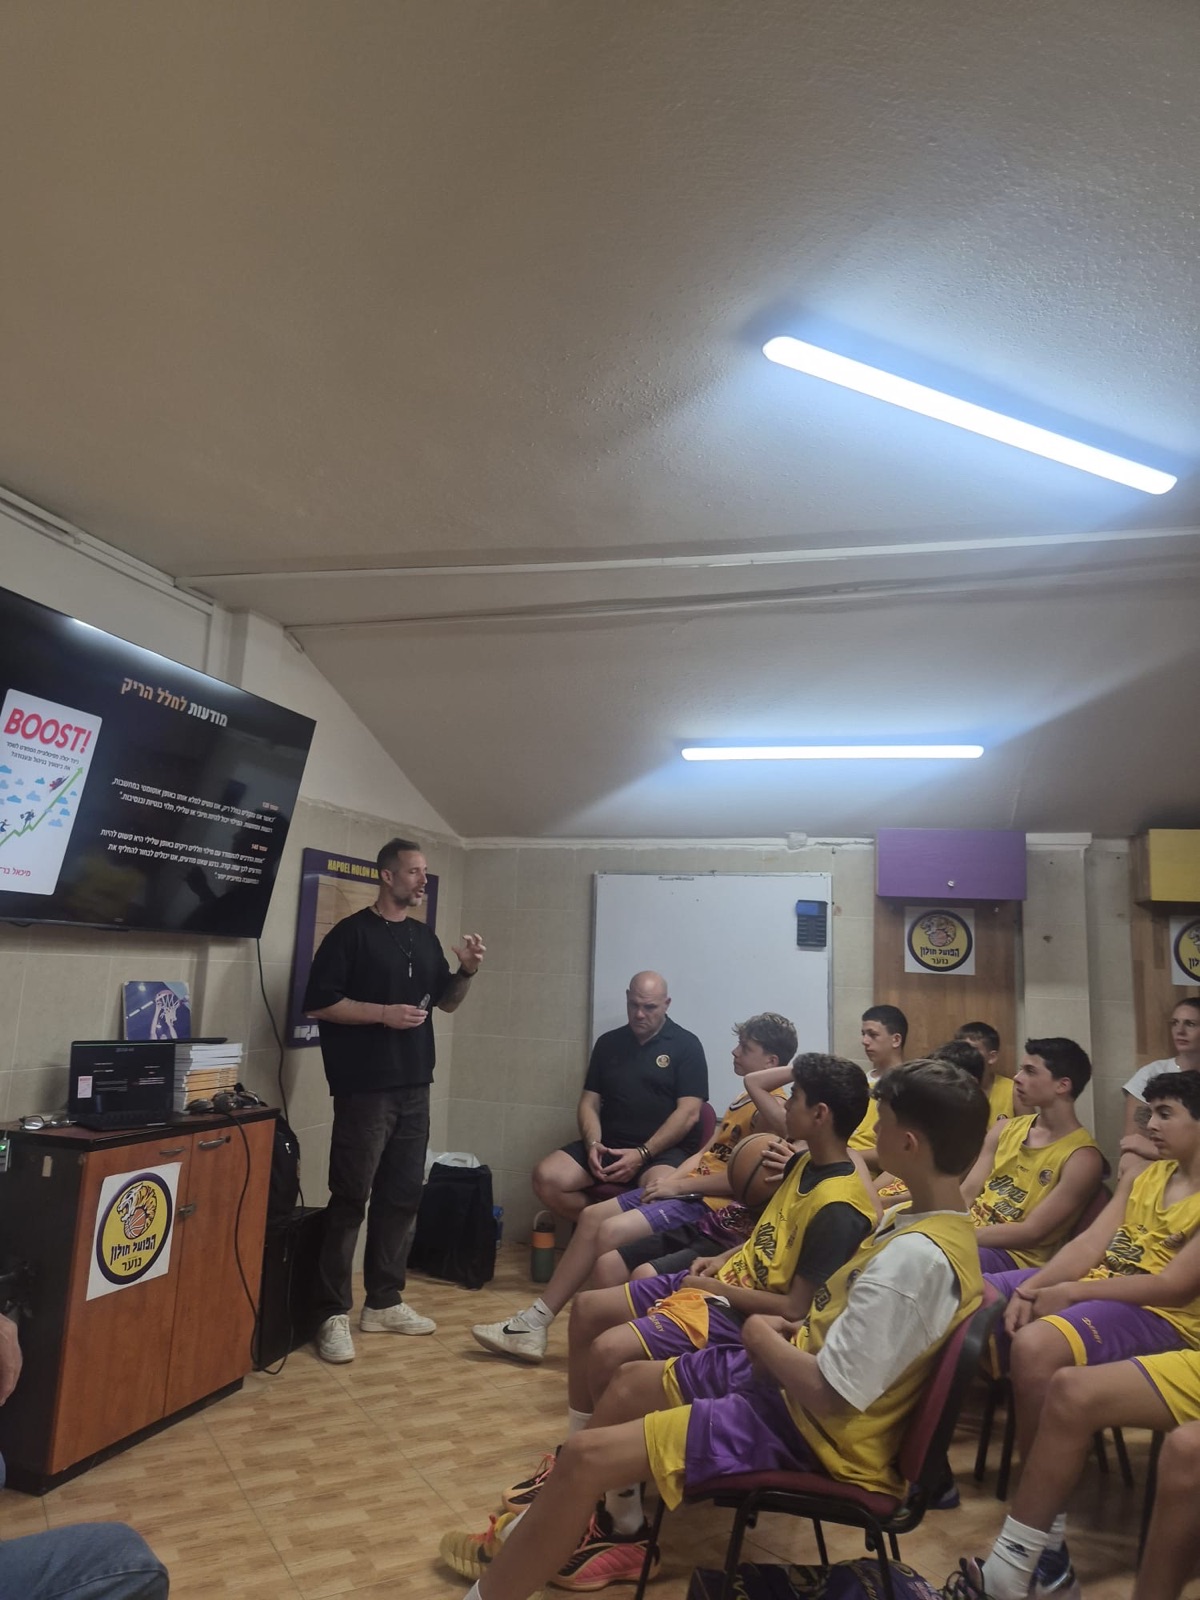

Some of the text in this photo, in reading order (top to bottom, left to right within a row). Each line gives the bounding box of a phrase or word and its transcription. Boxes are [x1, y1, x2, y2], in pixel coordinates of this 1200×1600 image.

[121, 678, 228, 727] מודעות לחלל הריק
[4, 708, 92, 754] BOOST!
[12, 867, 31, 876] מיכאל
[328, 860, 379, 879] HAPOEL HOLON BA
[920, 946, 959, 957] הפועל חולון
[110, 1234, 156, 1266] הפועל חולון
[122, 1257, 142, 1271] נוער
